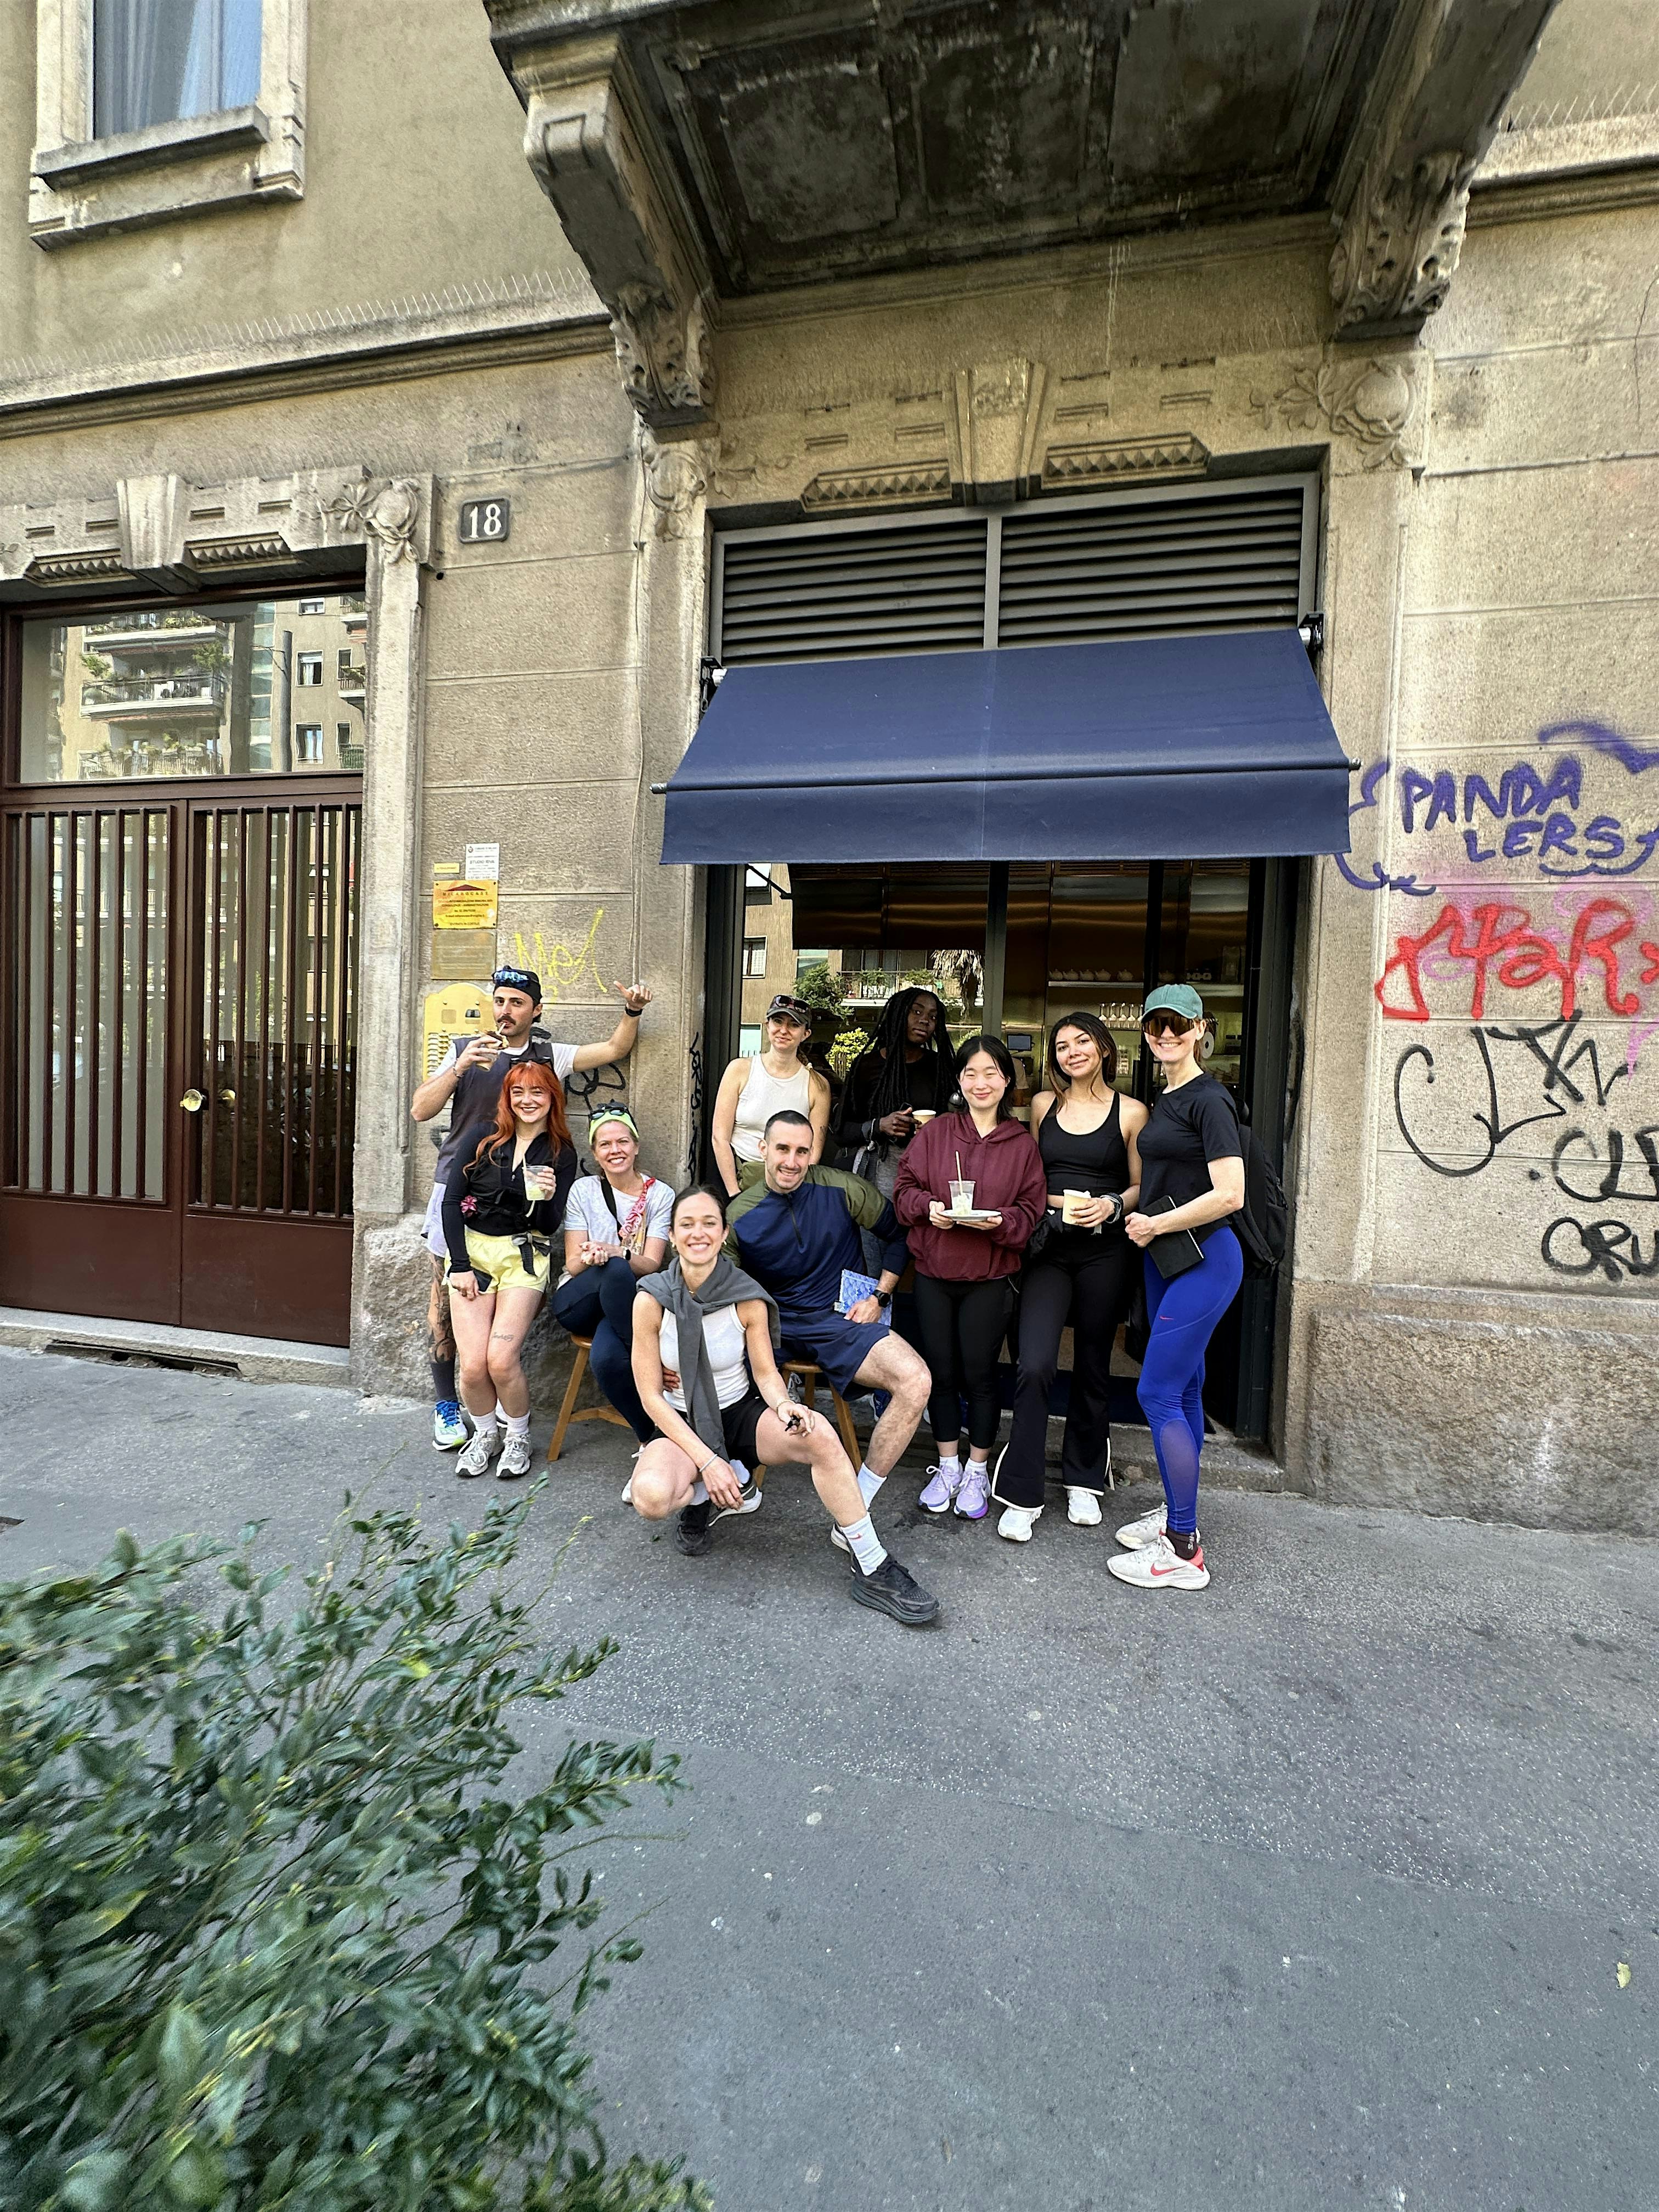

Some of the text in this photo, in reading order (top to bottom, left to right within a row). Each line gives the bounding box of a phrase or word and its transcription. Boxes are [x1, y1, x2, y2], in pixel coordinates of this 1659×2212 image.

[469, 504, 502, 538] 18
[1402, 758, 1581, 833] PANDA
[1464, 812, 1626, 862] LERS
